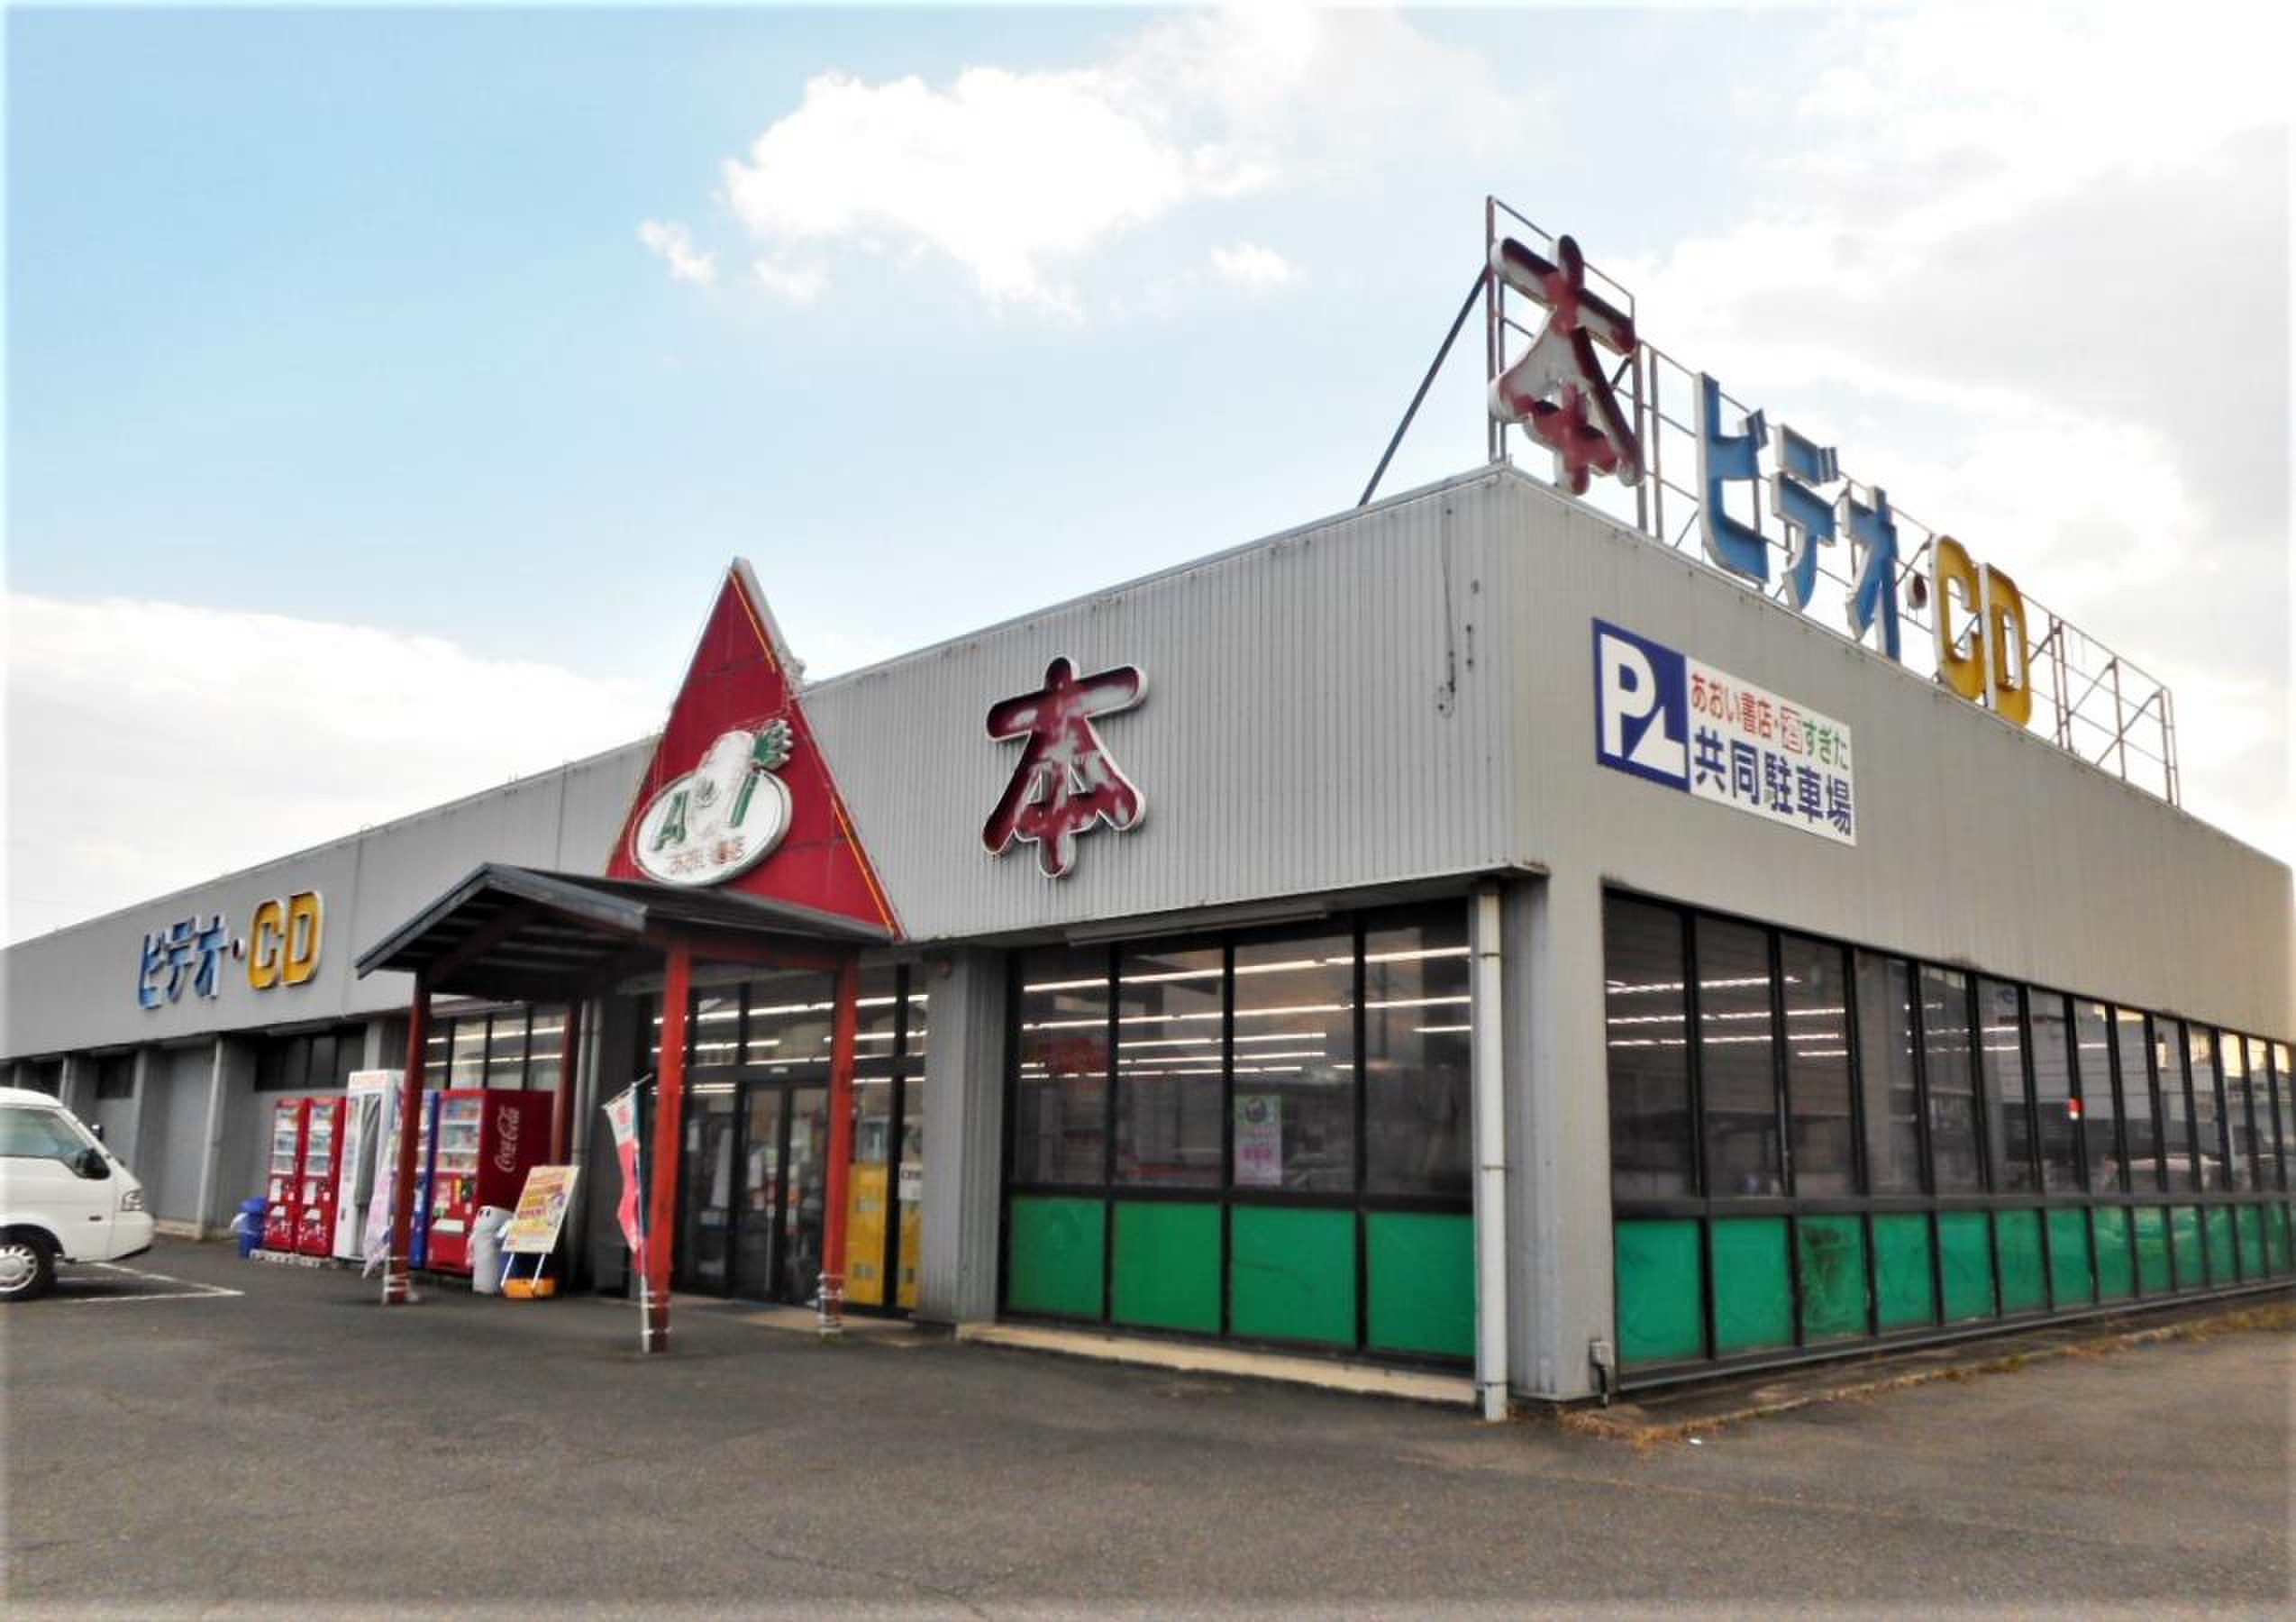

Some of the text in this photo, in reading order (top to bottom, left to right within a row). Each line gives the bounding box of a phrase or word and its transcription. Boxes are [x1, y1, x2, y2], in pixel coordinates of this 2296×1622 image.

[1489, 234, 1645, 497] 本
[982, 656, 1147, 878] 本
[1693, 726, 1852, 836] 共同駐車場
